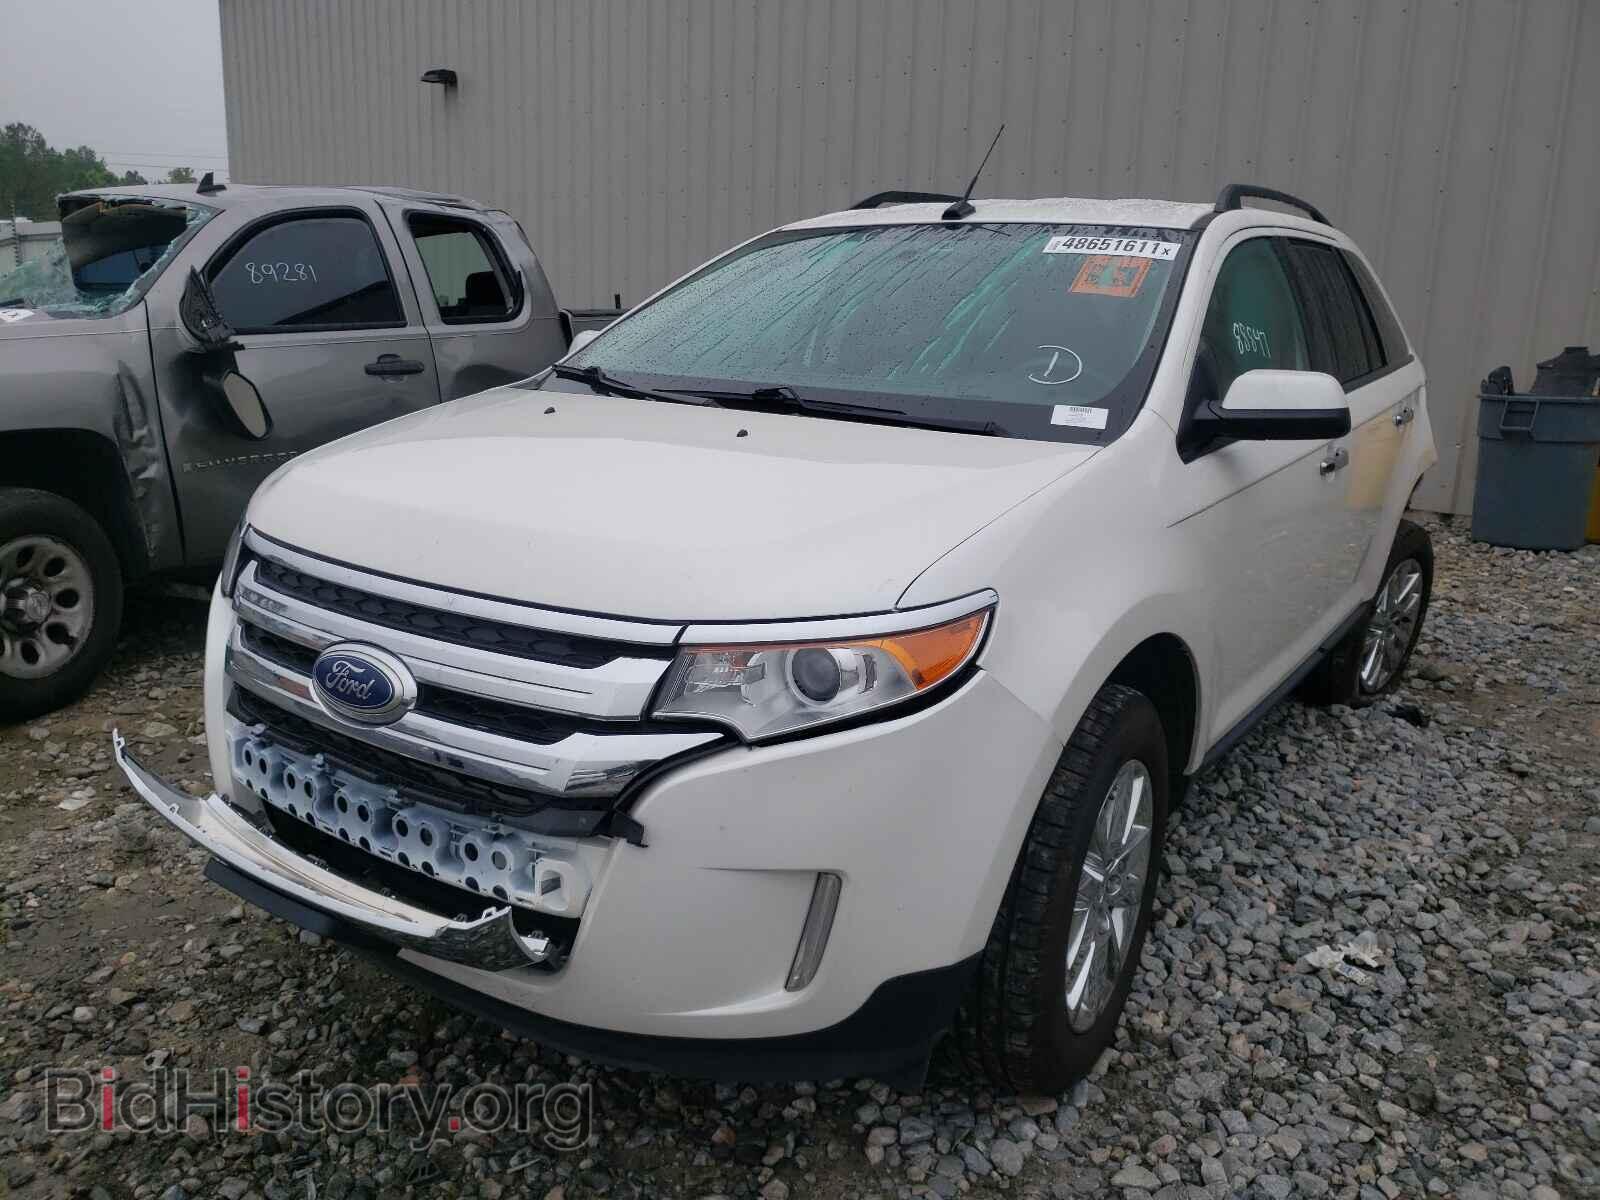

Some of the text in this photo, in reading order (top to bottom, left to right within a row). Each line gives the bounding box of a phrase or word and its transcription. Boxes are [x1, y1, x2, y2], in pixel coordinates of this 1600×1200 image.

[1062, 237, 1160, 254] 48651611
[245, 262, 317, 284] 89281
[326, 660, 376, 700] Ford
